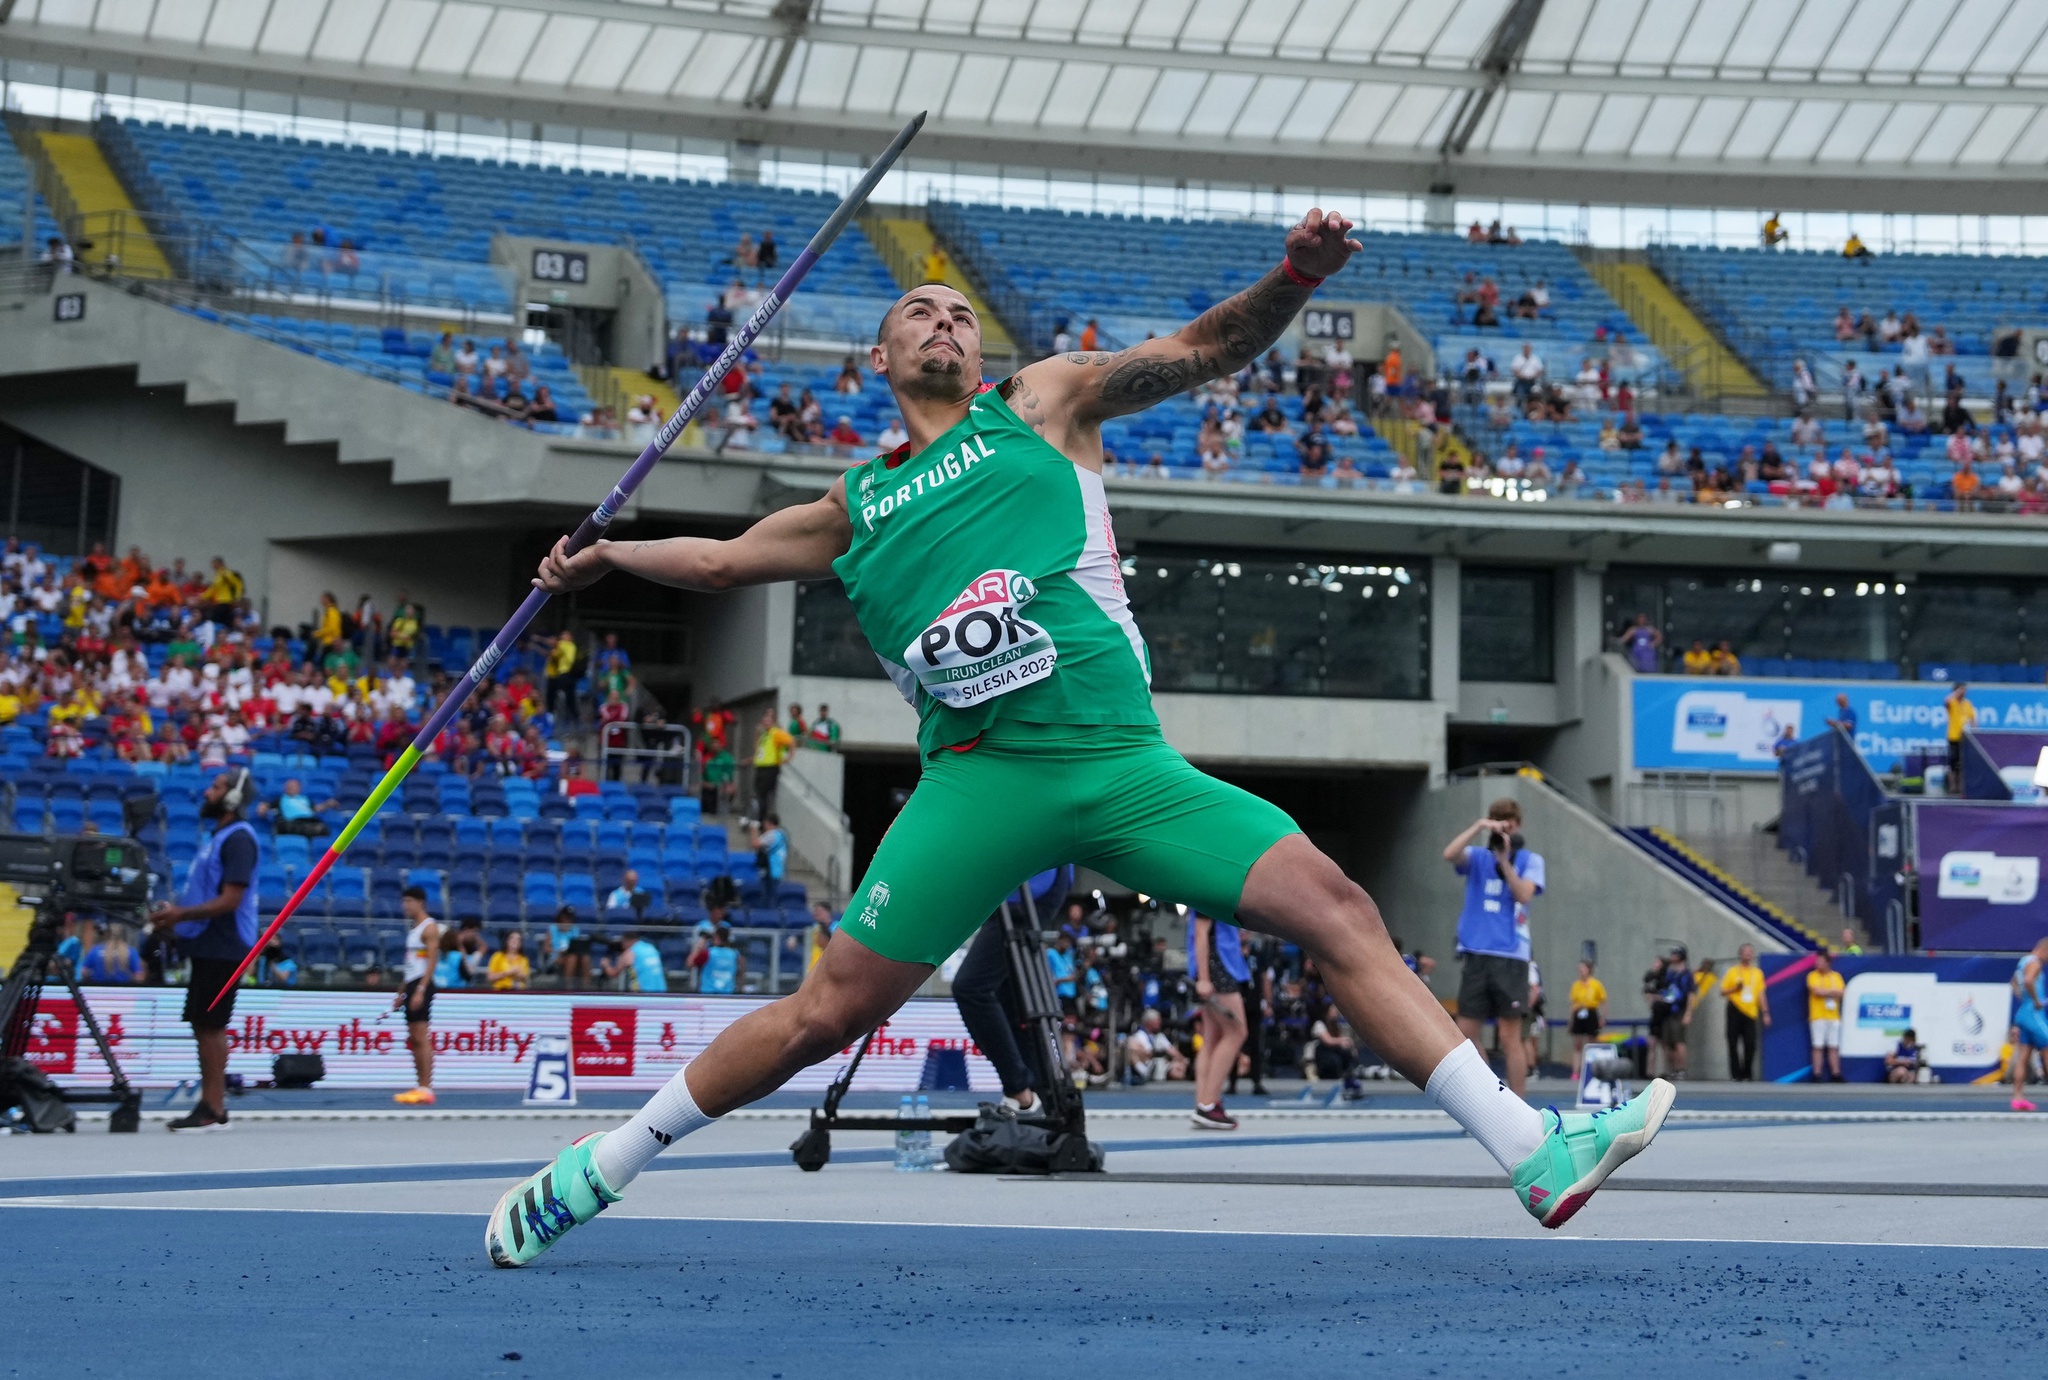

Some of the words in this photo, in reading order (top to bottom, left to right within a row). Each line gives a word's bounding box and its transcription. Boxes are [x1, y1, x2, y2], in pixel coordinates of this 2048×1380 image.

[536, 253, 565, 279] 03
[1307, 311, 1333, 336] 04
[653, 389, 703, 453] Nemeth
[749, 293, 781, 334] 85m
[862, 434, 996, 532] PORTUGAL
[469, 643, 502, 683] 800g
[951, 663, 980, 680] RUN
[962, 669, 1018, 700] SILESIA
[1019, 654, 1056, 679] 2023
[1869, 699, 1998, 729] Europn
[858, 912, 876, 930] FPA
[226, 1016, 328, 1052] ollow
[338, 1018, 392, 1053] the
[406, 1020, 534, 1063] uality
[534, 1060, 567, 1100] 5
